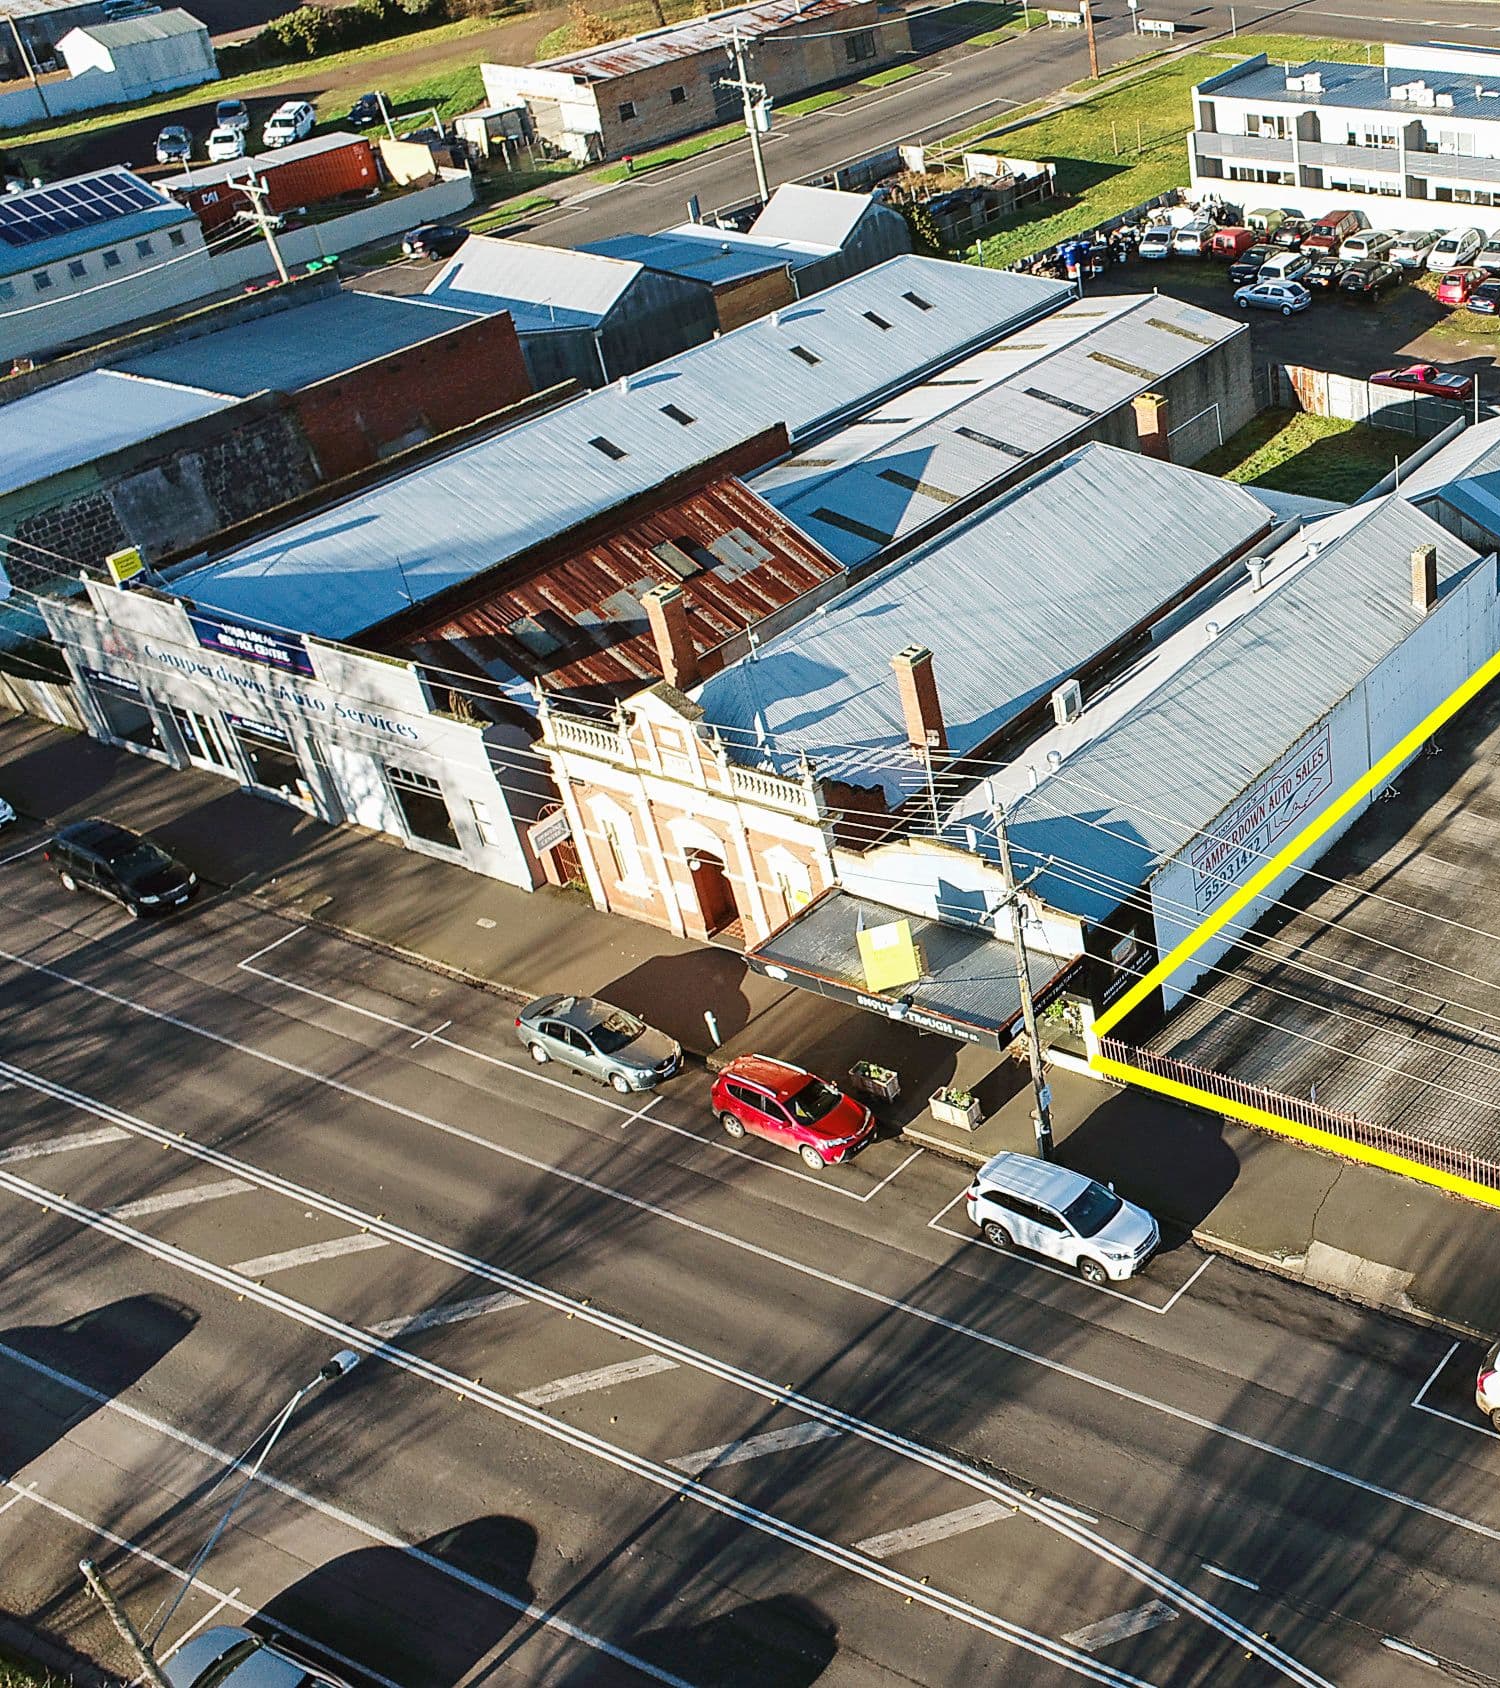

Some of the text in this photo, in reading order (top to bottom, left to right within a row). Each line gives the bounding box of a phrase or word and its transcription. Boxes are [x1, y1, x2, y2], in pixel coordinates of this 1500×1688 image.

[144, 644, 267, 695] Camperdown
[279, 685, 325, 712] Auto
[334, 702, 419, 740] Services
[1199, 747, 1324, 879] CAMPERDOWN AUTO SALES
[908, 1012, 953, 1034] TROUGH
